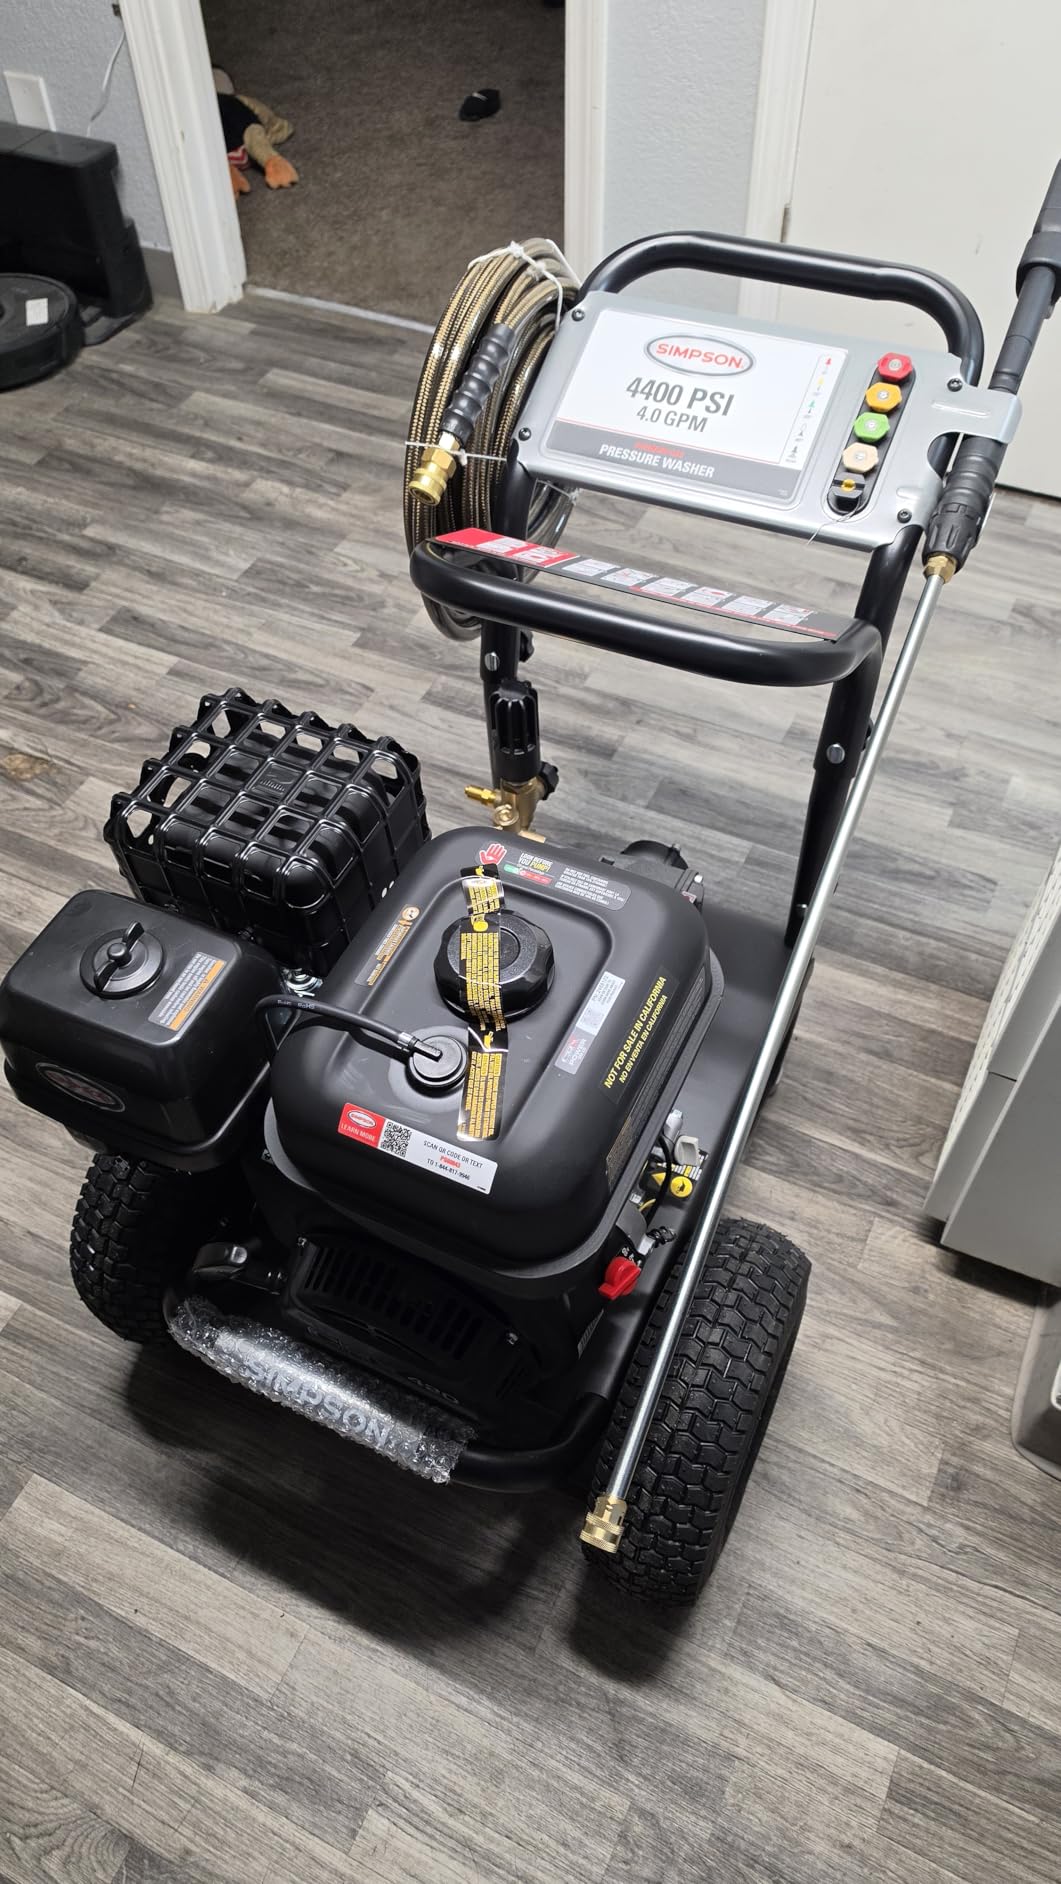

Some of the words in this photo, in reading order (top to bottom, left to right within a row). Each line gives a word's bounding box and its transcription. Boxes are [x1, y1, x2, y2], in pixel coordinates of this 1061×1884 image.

[656, 343, 743, 369] SIMPSON
[626, 377, 684, 406] 4400
[686, 387, 735, 417] PSI
[636, 405, 662, 423] 4.0
[663, 410, 708, 433] GPM
[598, 444, 661, 467] PRESSURE
[662, 456, 716, 479] WASHER
[646, 994, 668, 1032] CALIFORNIA
[603, 1068, 616, 1089] NOT
[613, 1051, 628, 1070] FOR
[623, 1029, 639, 1053] SALE
[634, 1019, 643, 1033] IN
[639, 976, 667, 1022] CALIFORNIA
[640, 1029, 650, 1041] EN
[629, 1040, 645, 1062] VENTA
[618, 1070, 629, 1084] NO
[625, 1060, 634, 1072] EN
[340, 1123, 360, 1137] LEARN
[423, 1140, 439, 1151] SCAN
[438, 1146, 447, 1154] QR
[446, 1149, 461, 1161] CODE
[461, 1155, 471, 1164] OR
[469, 1158, 484, 1169] TEXT
[427, 1158, 435, 1166] TO
[247, 1363, 393, 1450] SIMPSON
